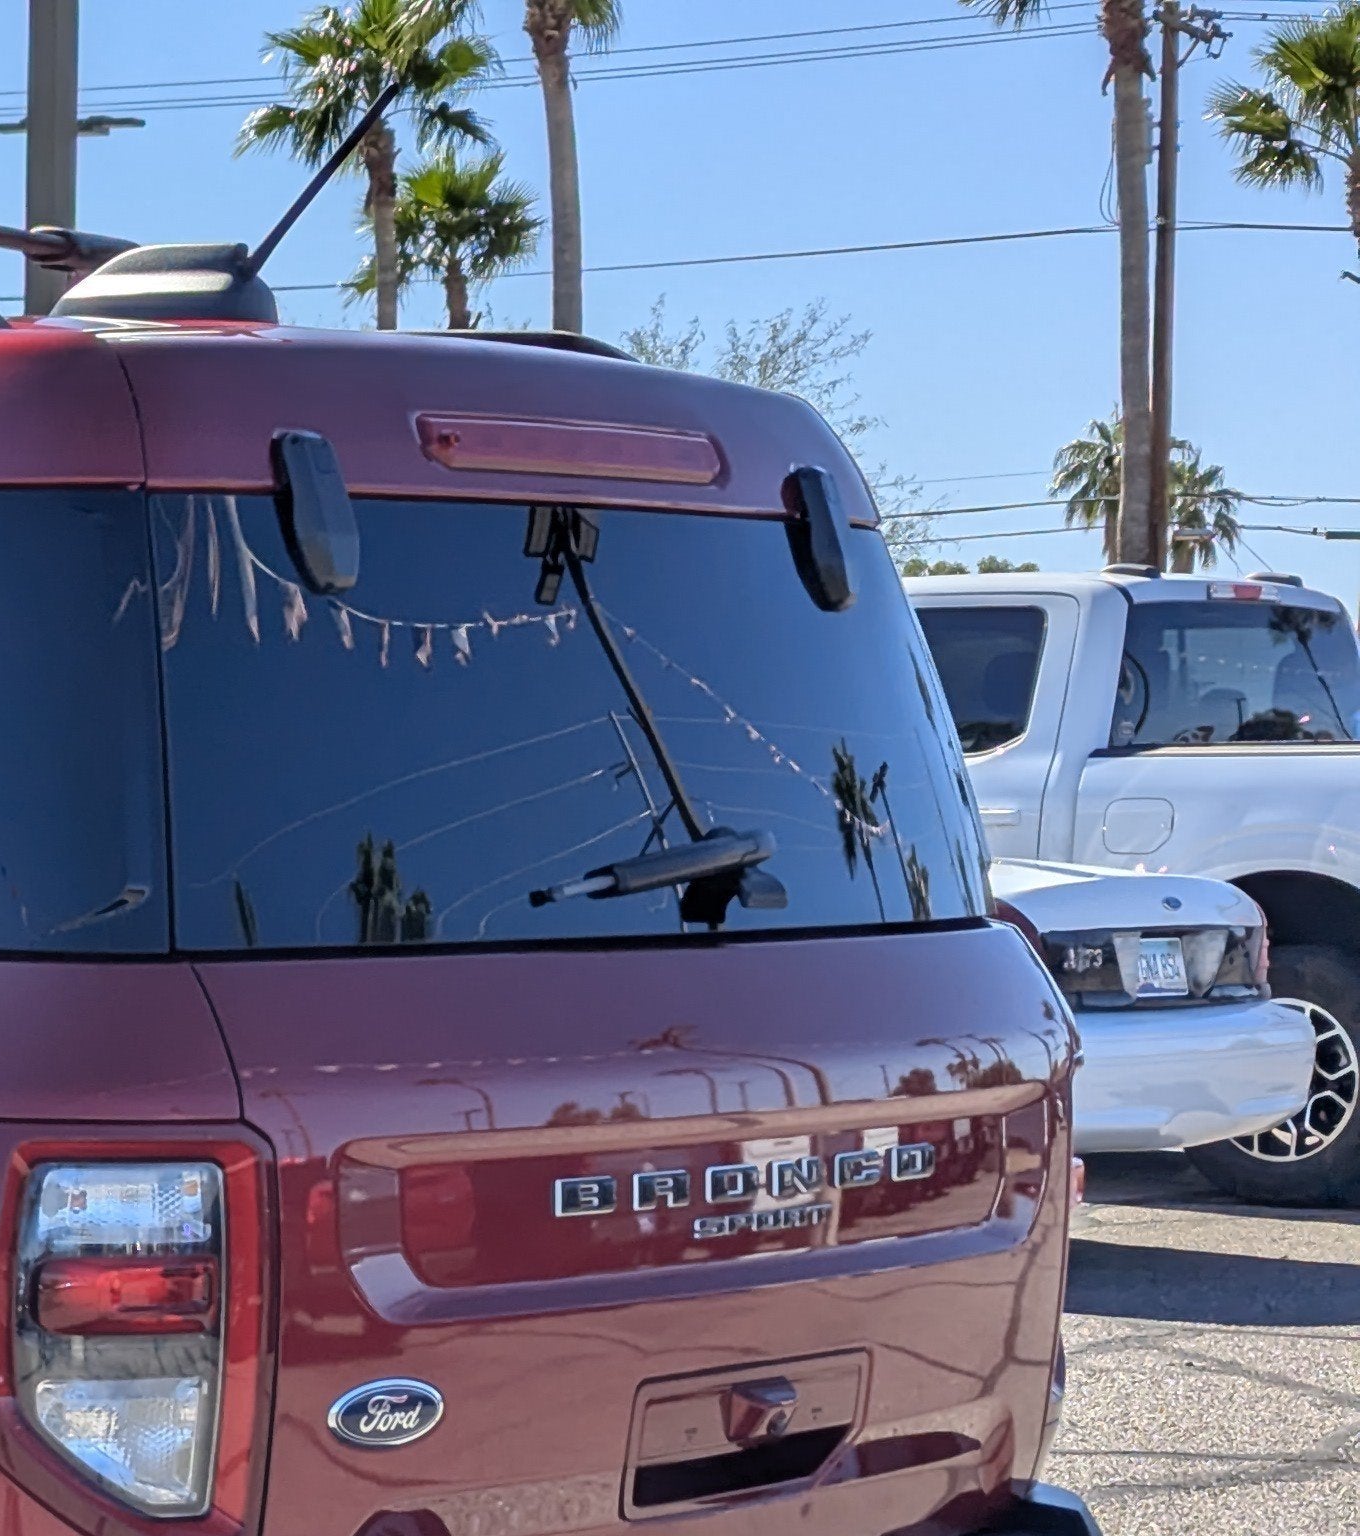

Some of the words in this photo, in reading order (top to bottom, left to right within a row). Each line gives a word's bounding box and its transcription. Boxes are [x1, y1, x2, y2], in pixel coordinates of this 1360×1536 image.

[553, 1142, 935, 1218] BRONCO
[693, 1203, 832, 1239] SPORT
[359, 1394, 423, 1433] Ford
